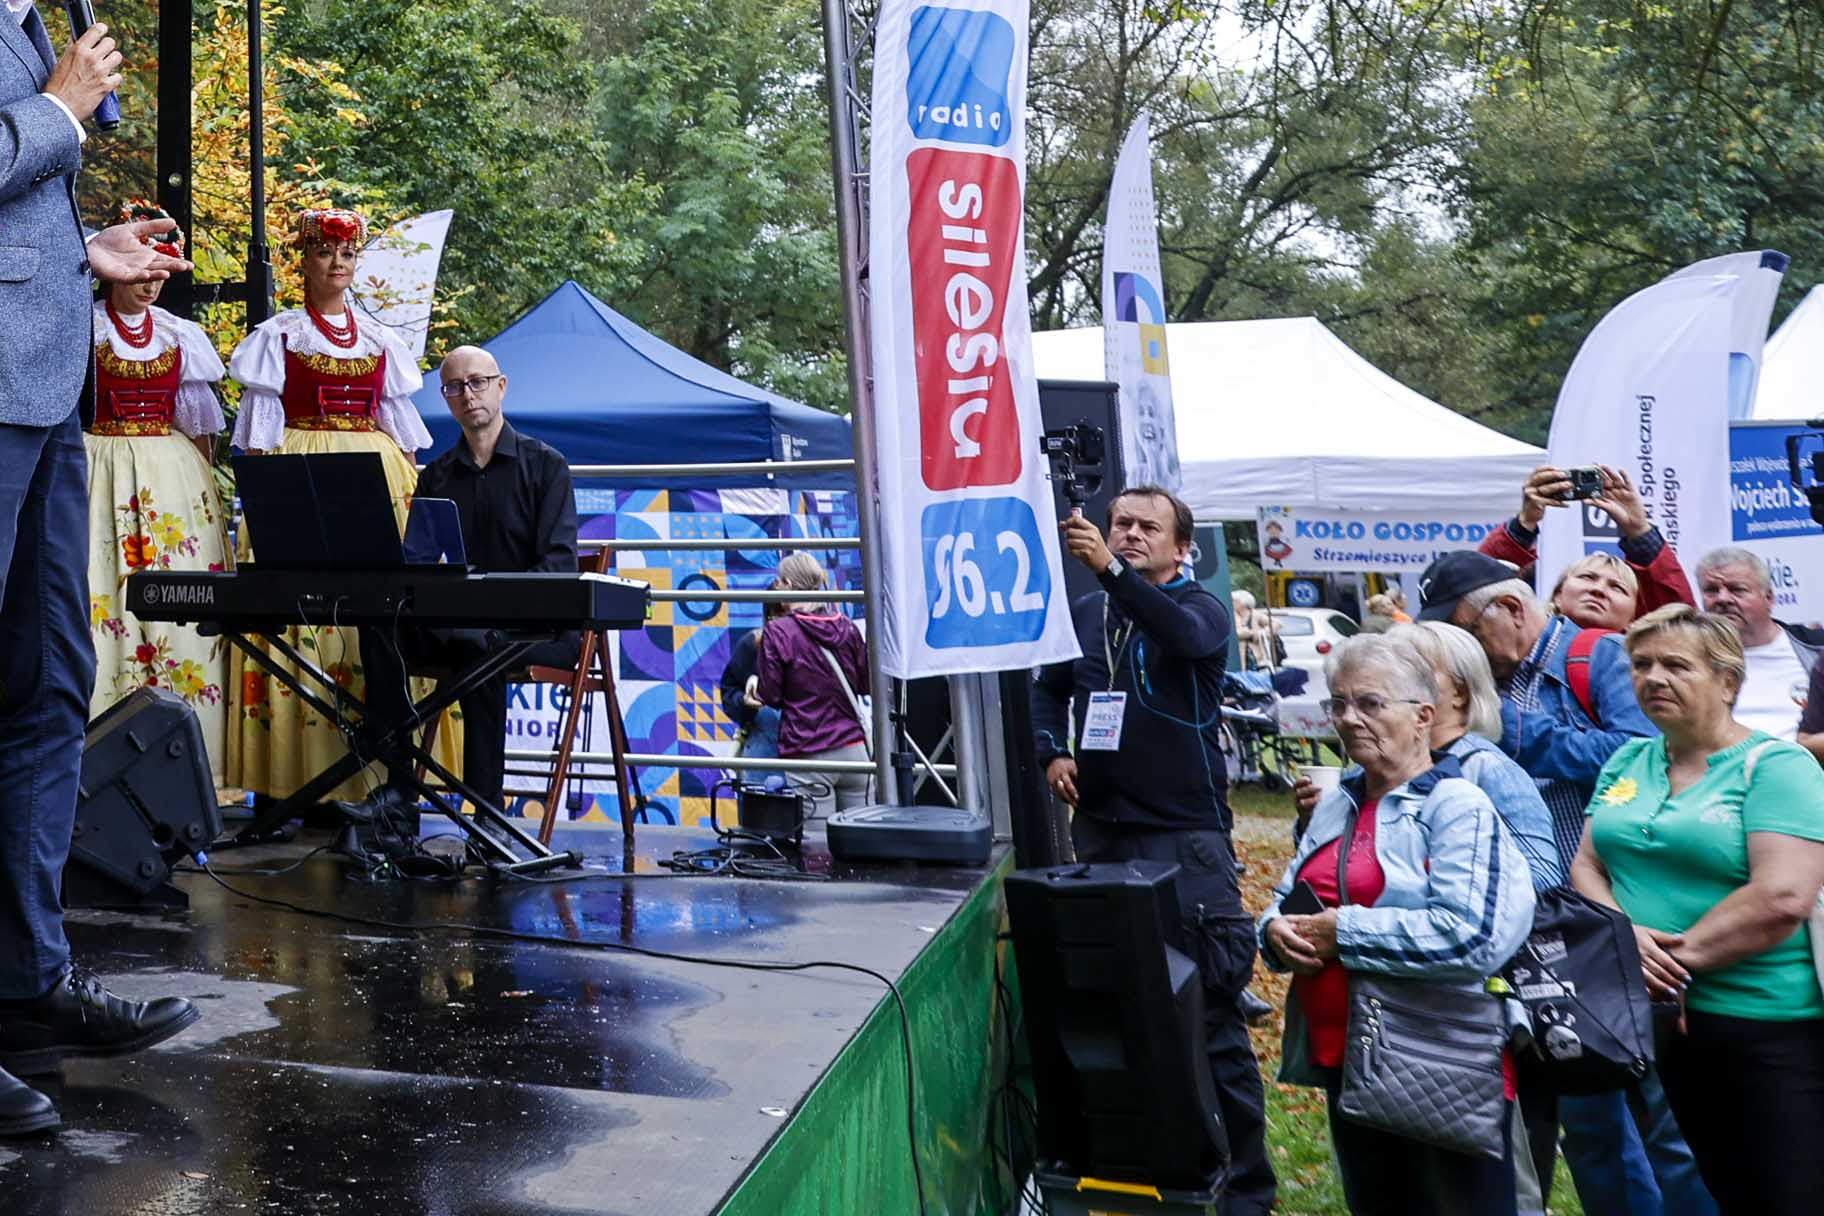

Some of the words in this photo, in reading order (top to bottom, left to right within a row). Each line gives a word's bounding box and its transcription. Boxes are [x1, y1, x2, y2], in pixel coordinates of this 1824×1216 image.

[918, 103, 1002, 131] radio
[1636, 394, 1657, 498] Społecznej
[1295, 519, 1366, 541] KOŁO
[932, 530, 1045, 619] 96.2
[161, 585, 215, 604] YAMAHA
